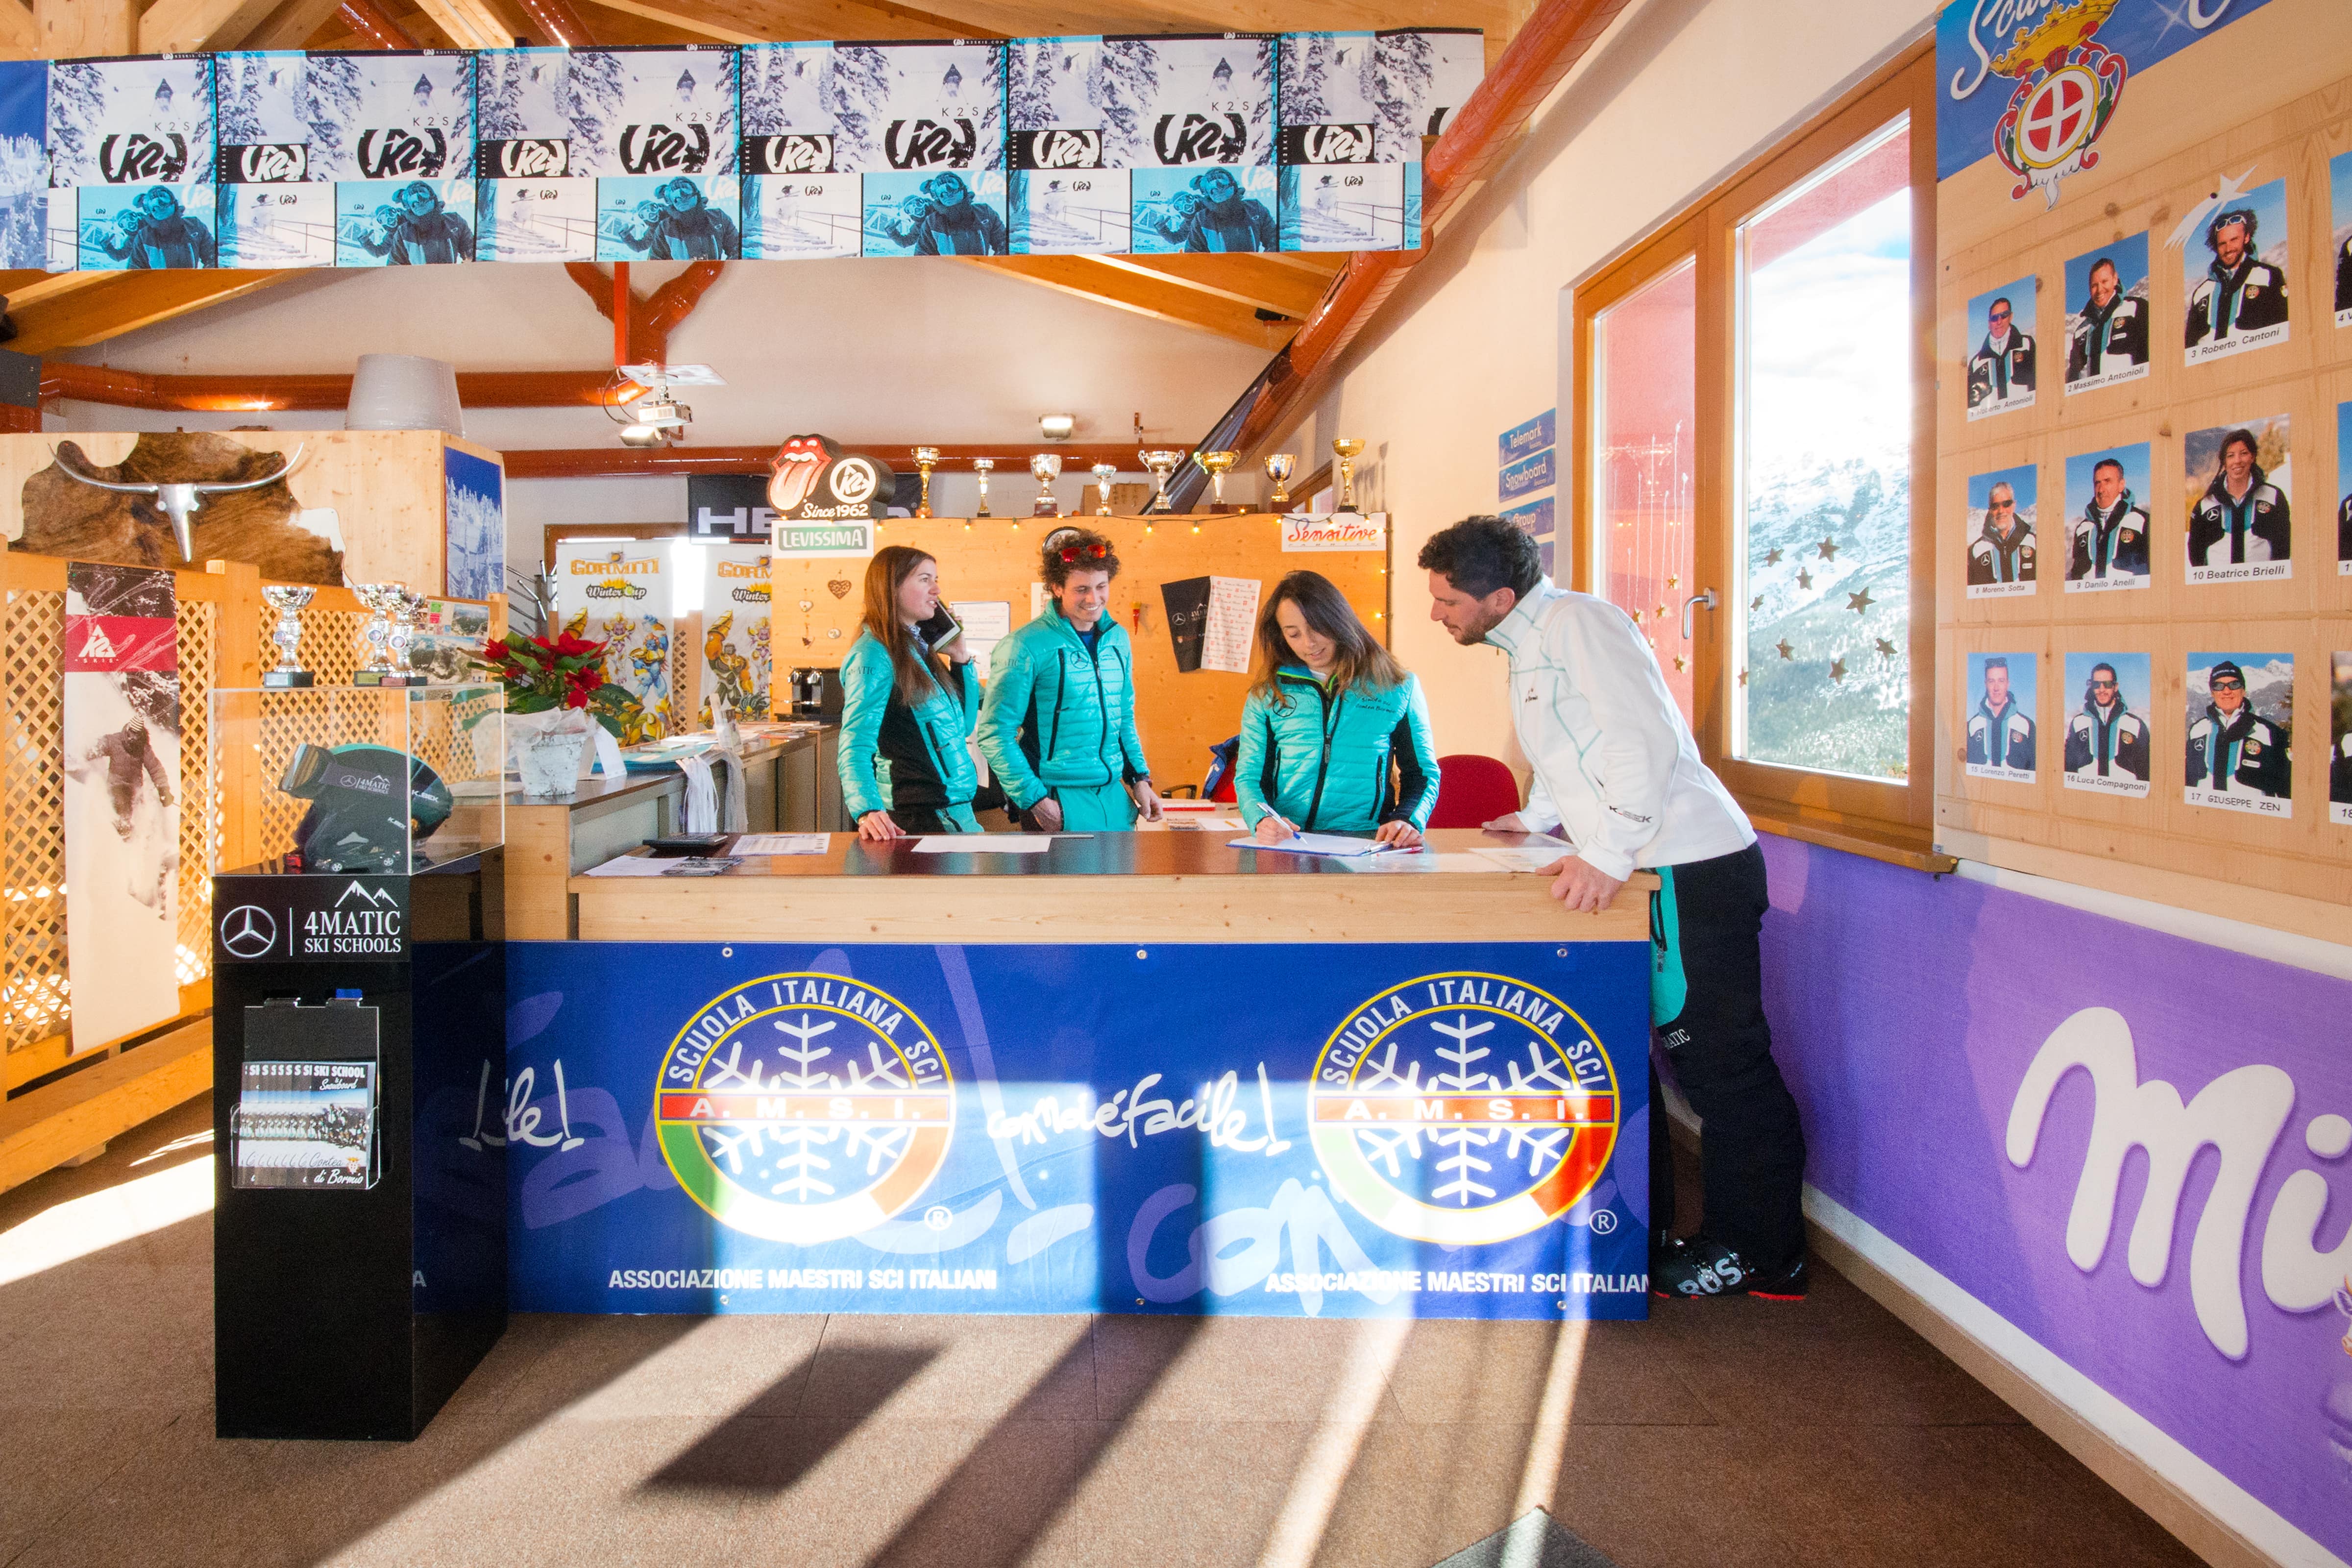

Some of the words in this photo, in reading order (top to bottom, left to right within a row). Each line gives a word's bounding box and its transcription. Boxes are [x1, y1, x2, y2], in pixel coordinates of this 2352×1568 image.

[2201, 340, 2236, 355] Roberto
[2242, 328, 2280, 344] Cantoni
[2073, 378, 2105, 390] Massimo
[2107, 366, 2144, 382] Antonioli
[2004, 394, 2033, 408] Antonioli
[1510, 420, 1542, 449] Telemark
[1506, 457, 1546, 488] Snowboard
[801, 503, 835, 518] Since
[835, 504, 869, 517] 1962
[783, 528, 863, 548] LEVISSIMA
[1288, 518, 1377, 542] Sensitive
[570, 558, 660, 575] GORMITI
[2192, 571, 2204, 580] 10
[2206, 568, 2249, 579] Beatrice
[2253, 565, 2285, 576] Brielli
[2084, 580, 2108, 588] Danilo
[2112, 578, 2135, 587] Anelli
[588, 586, 622, 598] Winter
[623, 587, 646, 600] Cup
[734, 589, 769, 602] Winter
[1981, 768, 2005, 776] Lorenzo
[2008, 771, 2030, 779] Peretti
[361, 779, 390, 790] 4MATIC
[2096, 778, 2147, 791] Compagnoni
[2207, 795, 2252, 808] GIUSEPPE
[2259, 802, 2280, 811] ZEN
[304, 910, 401, 935] 4MATIC
[304, 938, 329, 953] SKI
[333, 937, 401, 953] SCHOOLS
[668, 994, 757, 1082] SCUOLA
[772, 980, 904, 1036] ITALIANA
[905, 1040, 943, 1085] SCI
[1322, 995, 1412, 1085] SCUOLA
[1428, 980, 1565, 1035] ITALIANA
[1566, 1039, 1606, 1086] SCI
[314, 1065, 329, 1077] SKI
[331, 1066, 366, 1078] SCHOOL
[319, 1078, 358, 1091] Snowboard
[309, 1152, 343, 1167] Contea
[314, 1169, 326, 1183] di
[327, 1169, 364, 1184] Bormio
[608, 1268, 762, 1290] ASSOCIAZIONE
[767, 1269, 861, 1290] MAESTRI
[869, 1269, 903, 1290] SCI
[909, 1269, 997, 1290] ITALIANI
[1265, 1270, 1422, 1293] ASSOCIAZIONE
[1427, 1271, 1524, 1293] MAESTRI
[1531, 1273, 1566, 1294] SCI
